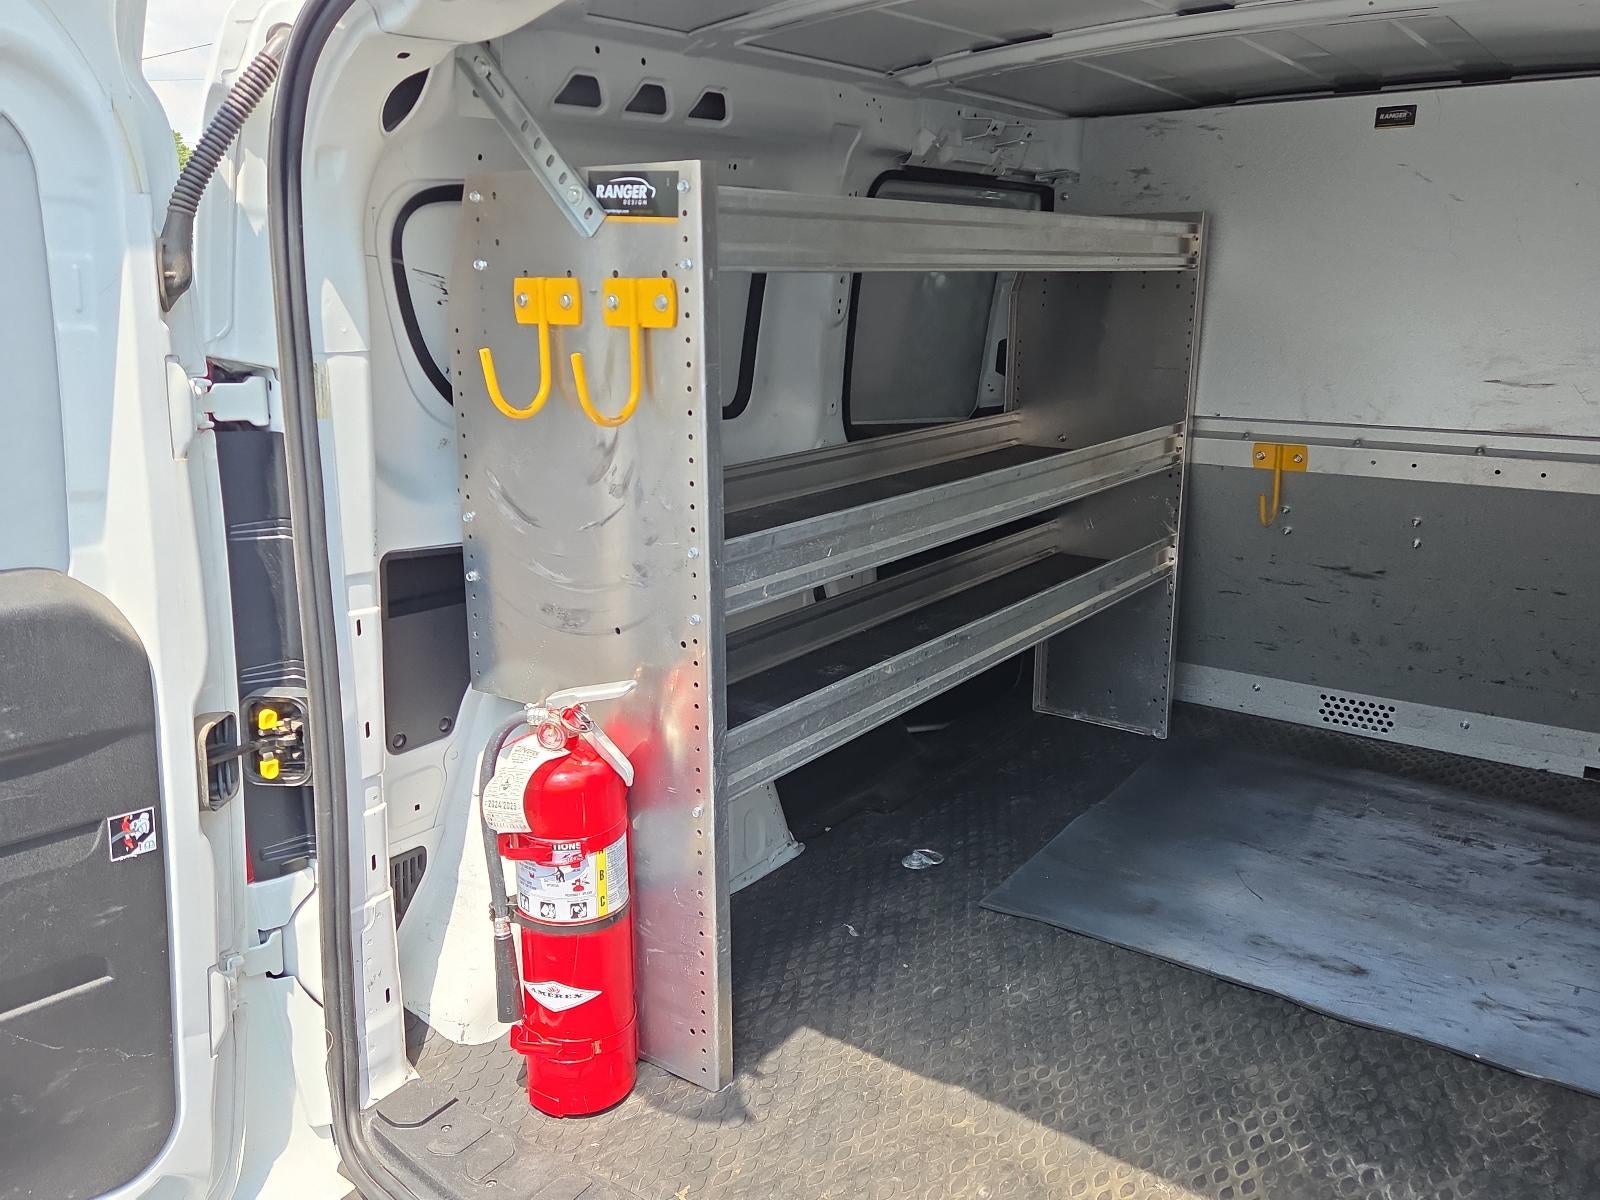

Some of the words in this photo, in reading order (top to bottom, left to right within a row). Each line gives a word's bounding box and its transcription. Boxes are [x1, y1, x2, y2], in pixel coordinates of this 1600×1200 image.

[596, 184, 648, 199] RANGER
[599, 869, 605, 881] B
[600, 895, 606, 907] C
